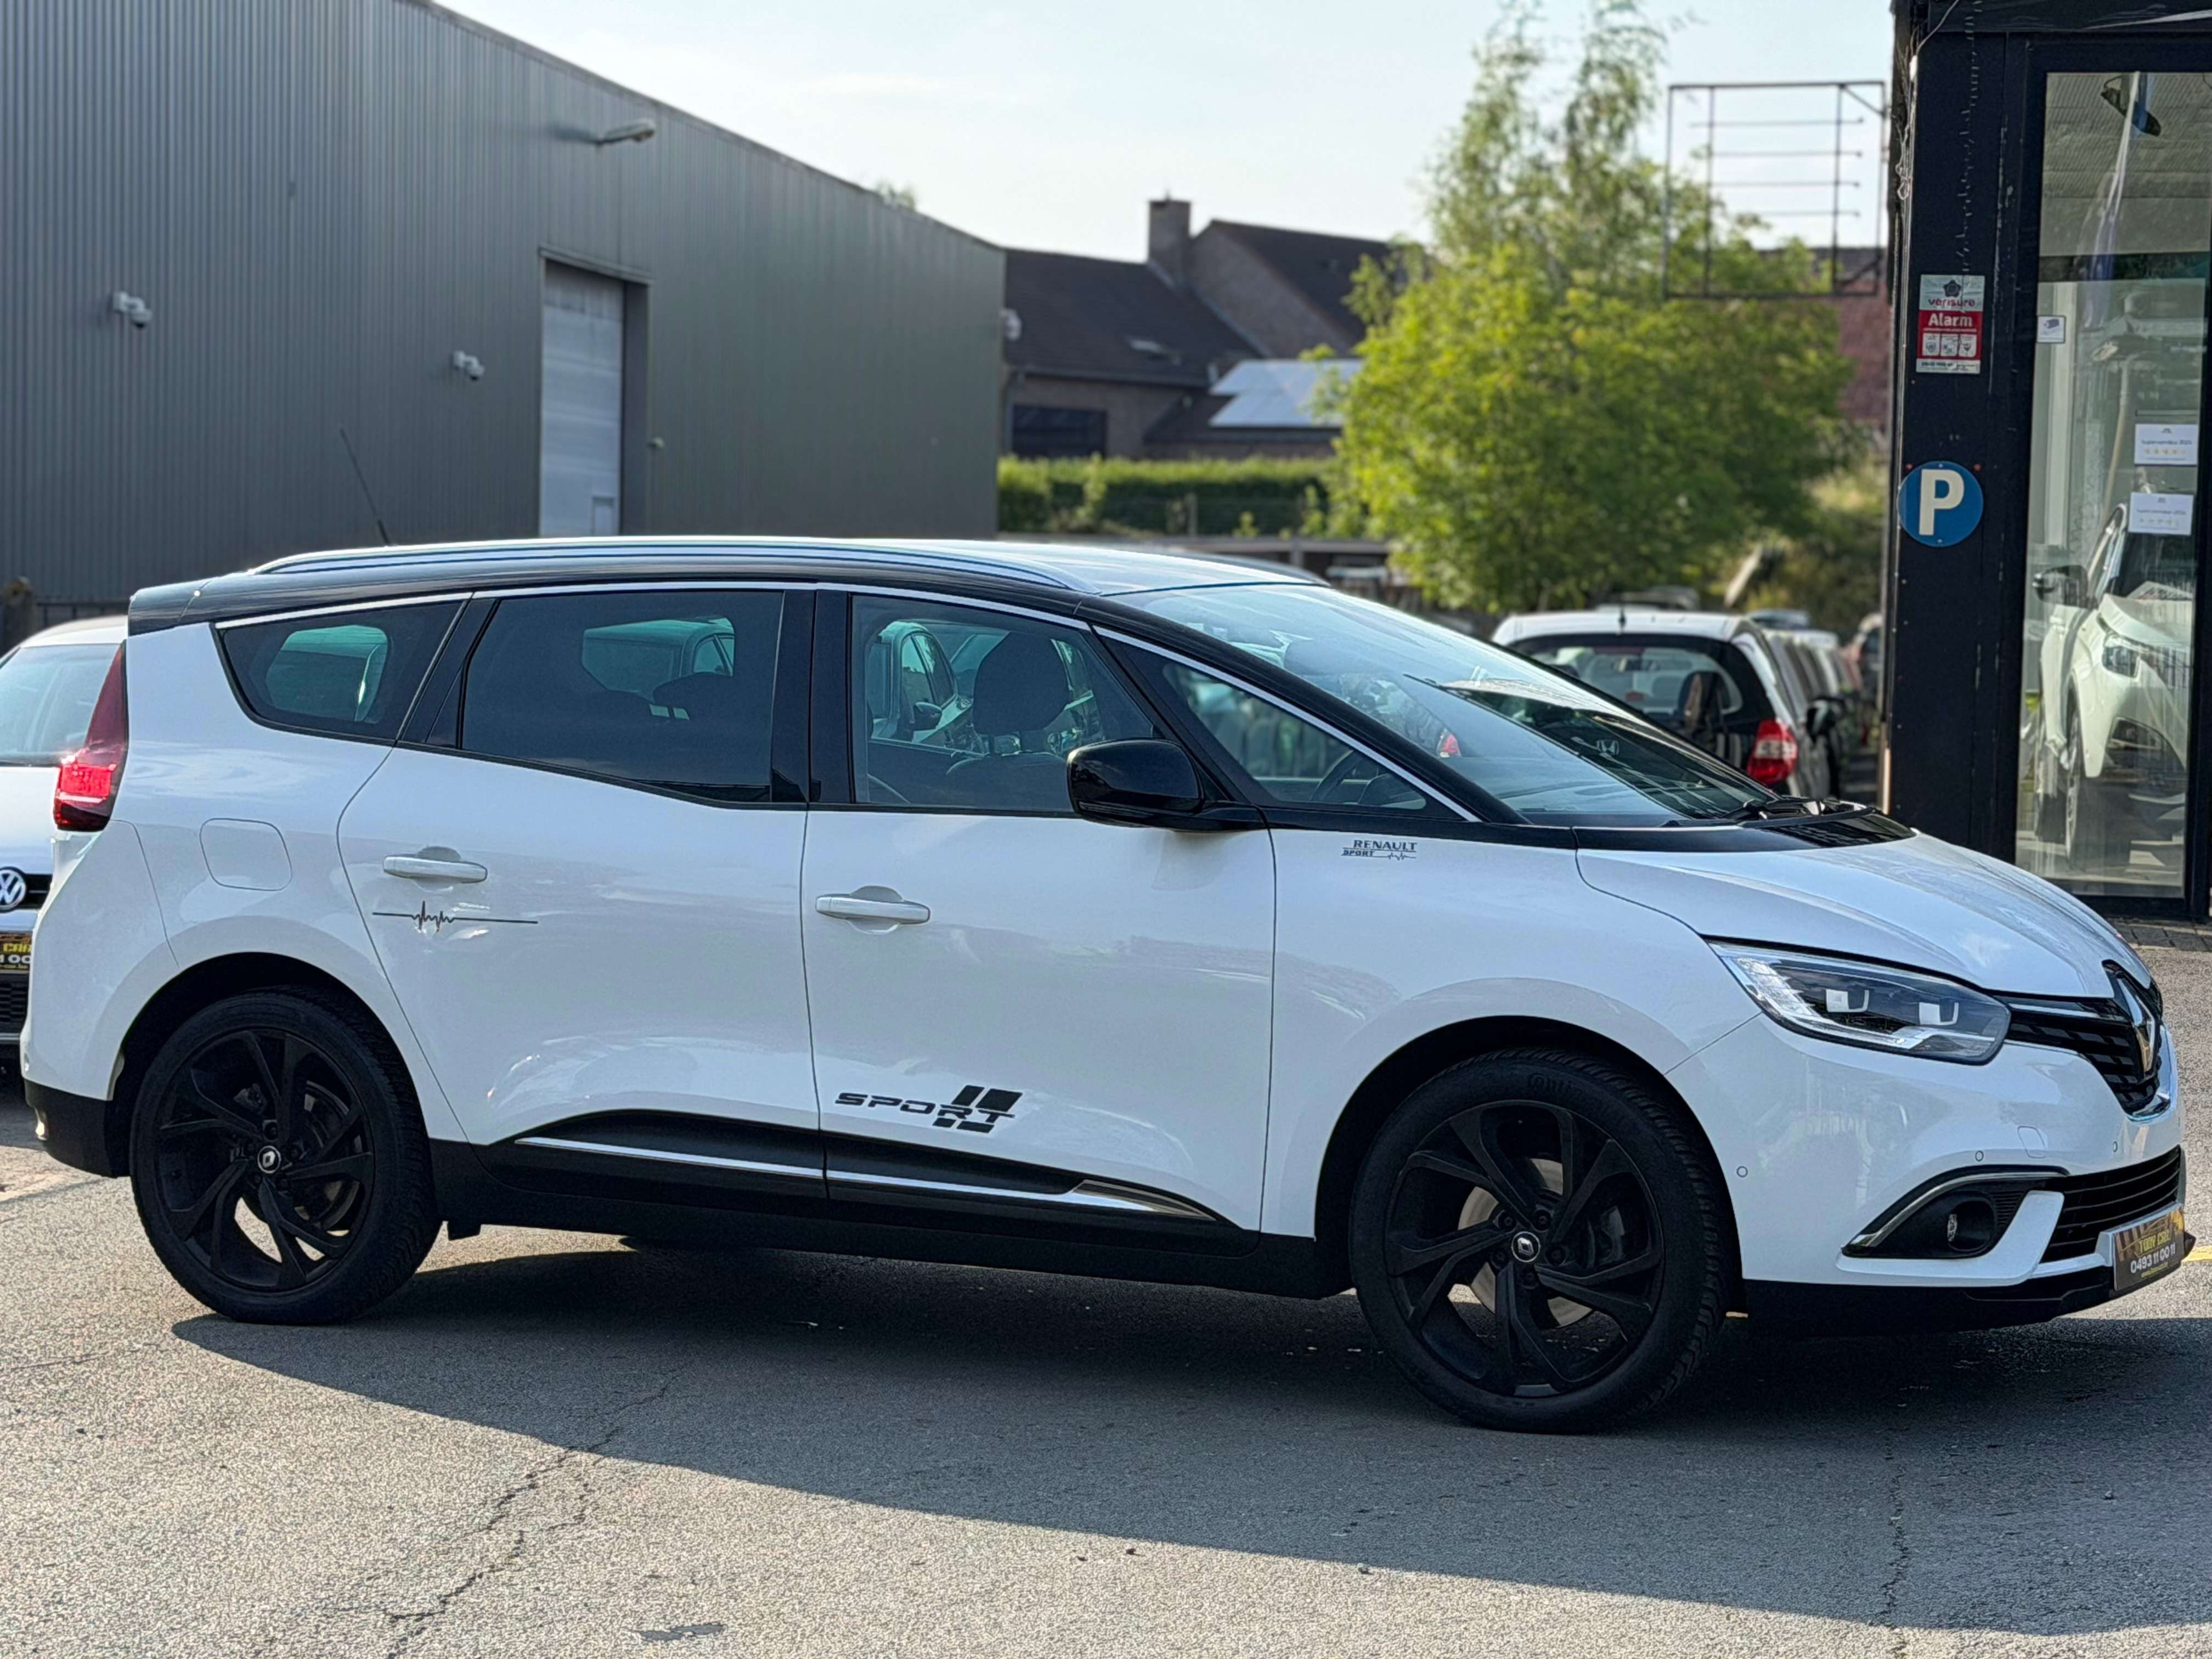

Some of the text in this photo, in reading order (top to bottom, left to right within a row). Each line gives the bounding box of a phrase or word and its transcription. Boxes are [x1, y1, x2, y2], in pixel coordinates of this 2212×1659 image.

[1928, 298, 1976, 307] verisure
[1928, 312, 1973, 326] Alarm
[1919, 469, 1964, 535] P
[1353, 839, 1418, 851] RENAULT
[1341, 849, 1375, 857] SPORT
[835, 1092, 1015, 1123] SPORT
[2130, 1255, 2152, 1273] 0493
[2153, 1250, 2159, 1265] 11
[2160, 1245, 2170, 1261] 00
